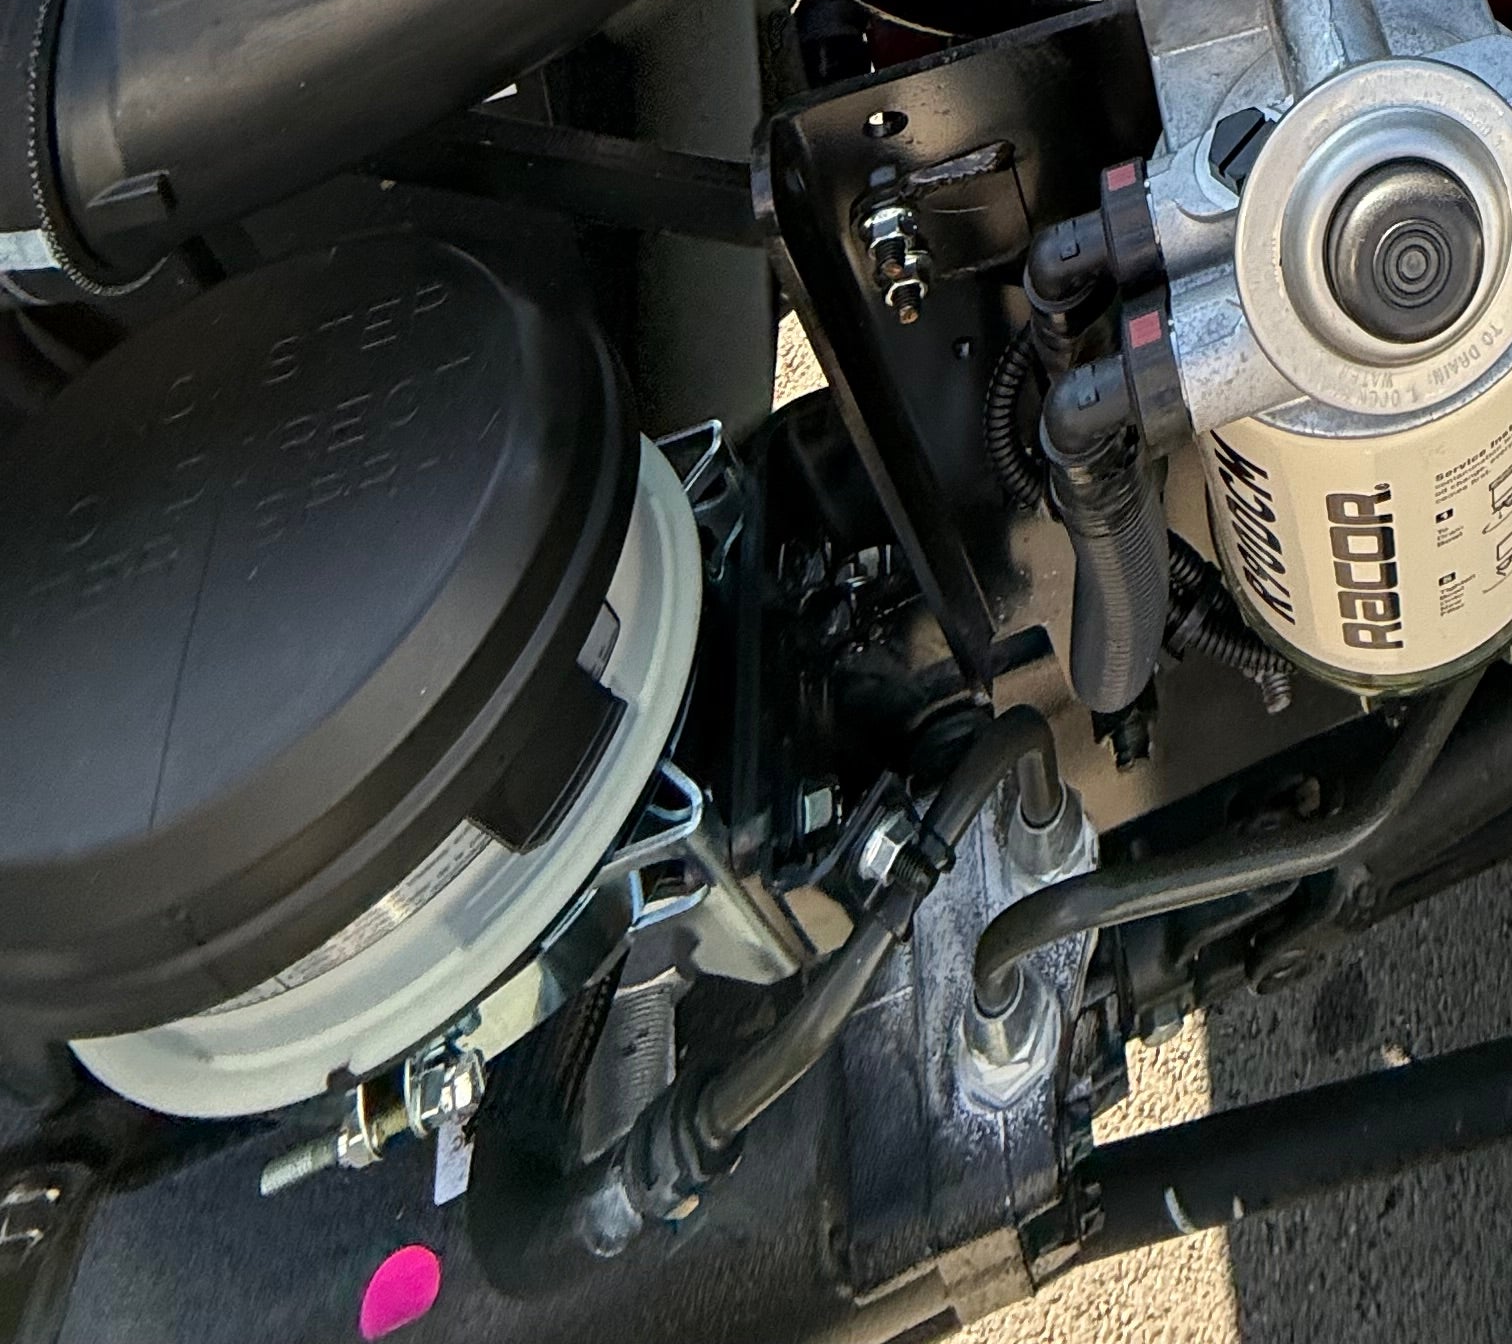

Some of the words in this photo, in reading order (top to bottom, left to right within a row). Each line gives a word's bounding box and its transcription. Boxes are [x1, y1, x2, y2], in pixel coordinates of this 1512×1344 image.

[262, 279, 452, 388] STEP
[1485, 320, 1506, 349] TO
[1435, 447, 1488, 483] Service
[1326, 490, 1404, 650] RACOR
